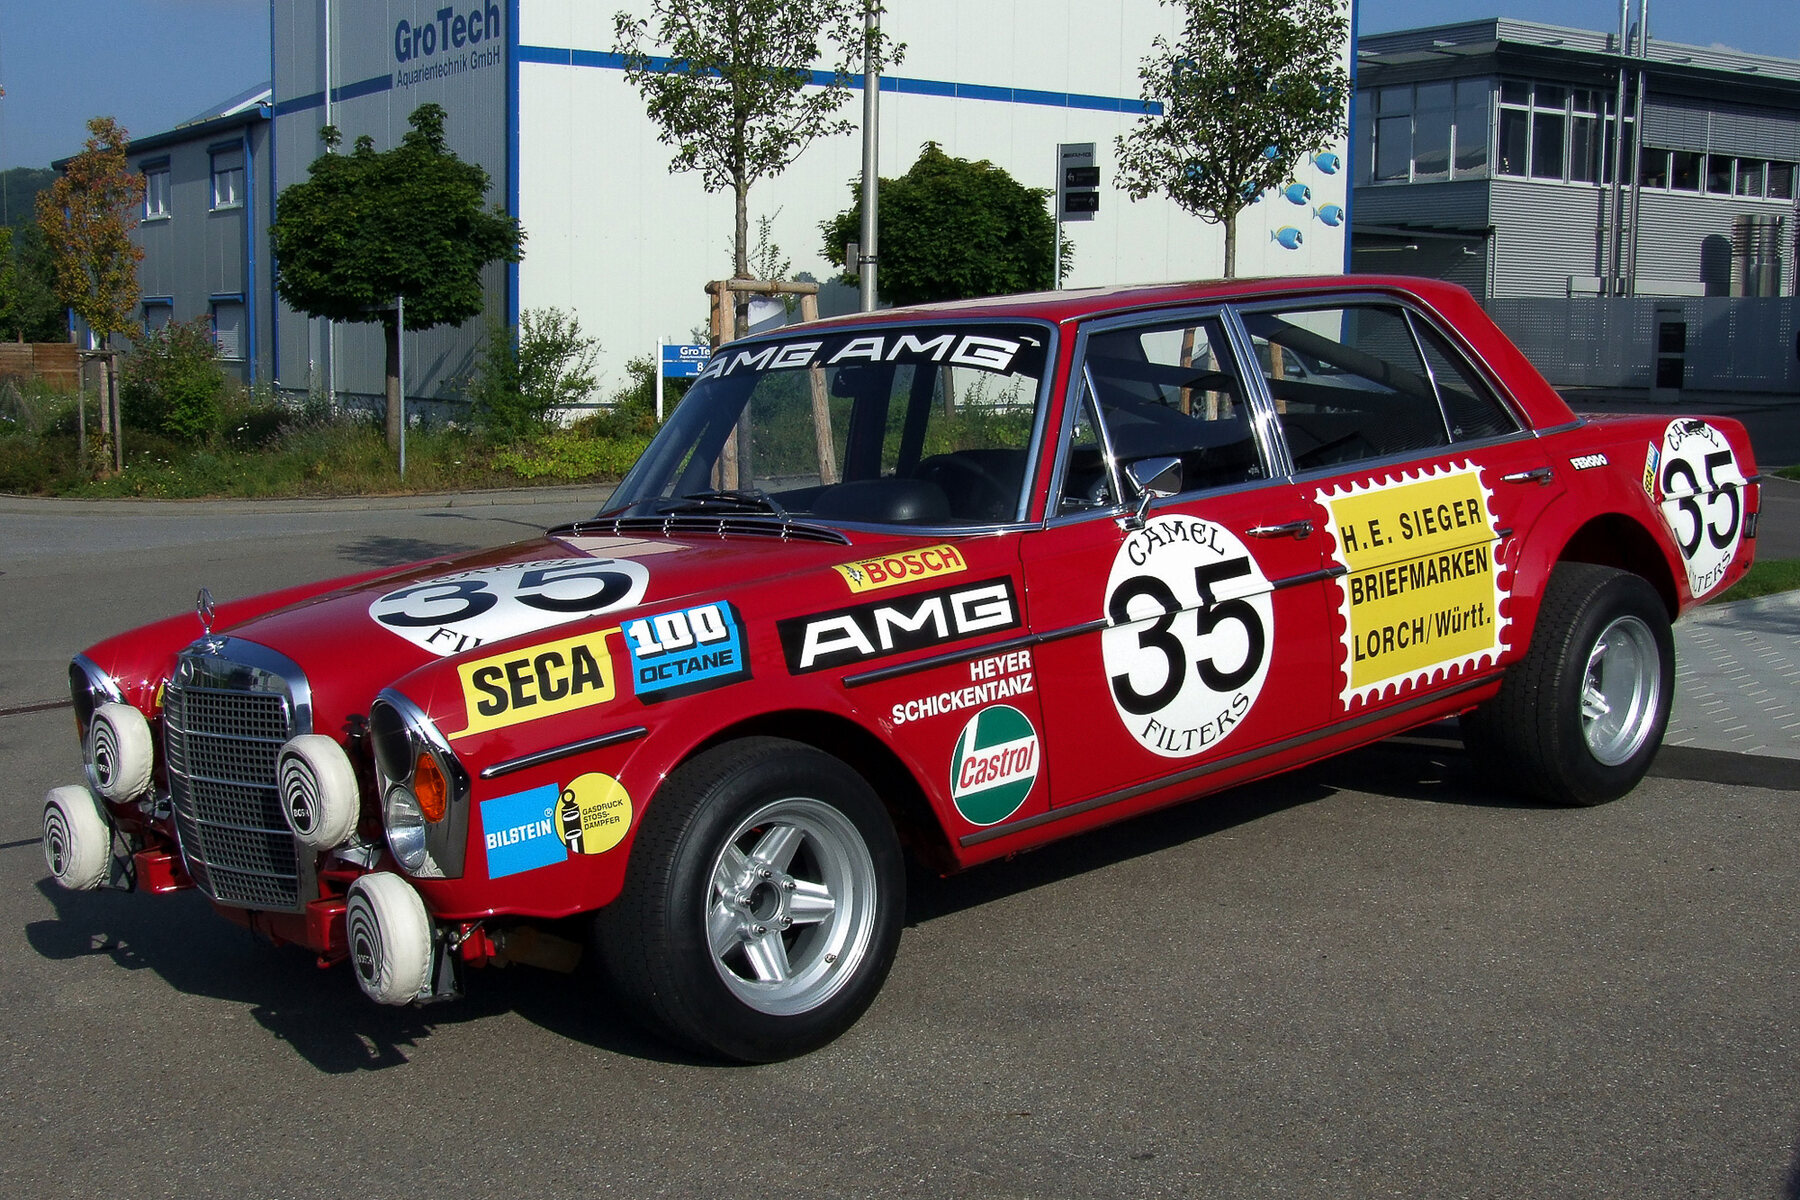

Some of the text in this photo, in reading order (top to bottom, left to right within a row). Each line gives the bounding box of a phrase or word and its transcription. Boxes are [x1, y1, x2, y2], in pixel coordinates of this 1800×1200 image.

[395, 0, 500, 63] GroTech
[396, 45, 500, 88] Aquarientechnik GmbH
[680, 346, 710, 356] GroTe
[702, 334, 1020, 379] AMG AMG
[1570, 453, 1608, 470] FERODO
[1341, 498, 1482, 554] H.E. SIEGER
[1662, 449, 1739, 561] 35
[861, 546, 961, 584] BOSCH
[1128, 520, 1225, 567] CAMEL
[377, 559, 633, 628] 35
[1351, 546, 1488, 606] BRIEFMARKEN
[629, 604, 729, 658] 100
[799, 583, 1014, 669] AMG
[1109, 555, 1265, 716] 35
[1354, 602, 1491, 662] LORCH/Württ.
[472, 644, 605, 717] SECA
[640, 649, 734, 684] OCTANE
[970, 650, 1031, 681] HEYER
[892, 673, 1033, 725] SCHICKENTANZ
[1141, 692, 1249, 752] FILTERS
[960, 740, 1035, 789] Castrol
[582, 799, 623, 815] GASDRUCK
[583, 811, 610, 823] STOSS-
[486, 818, 552, 849] BILSTEIN
